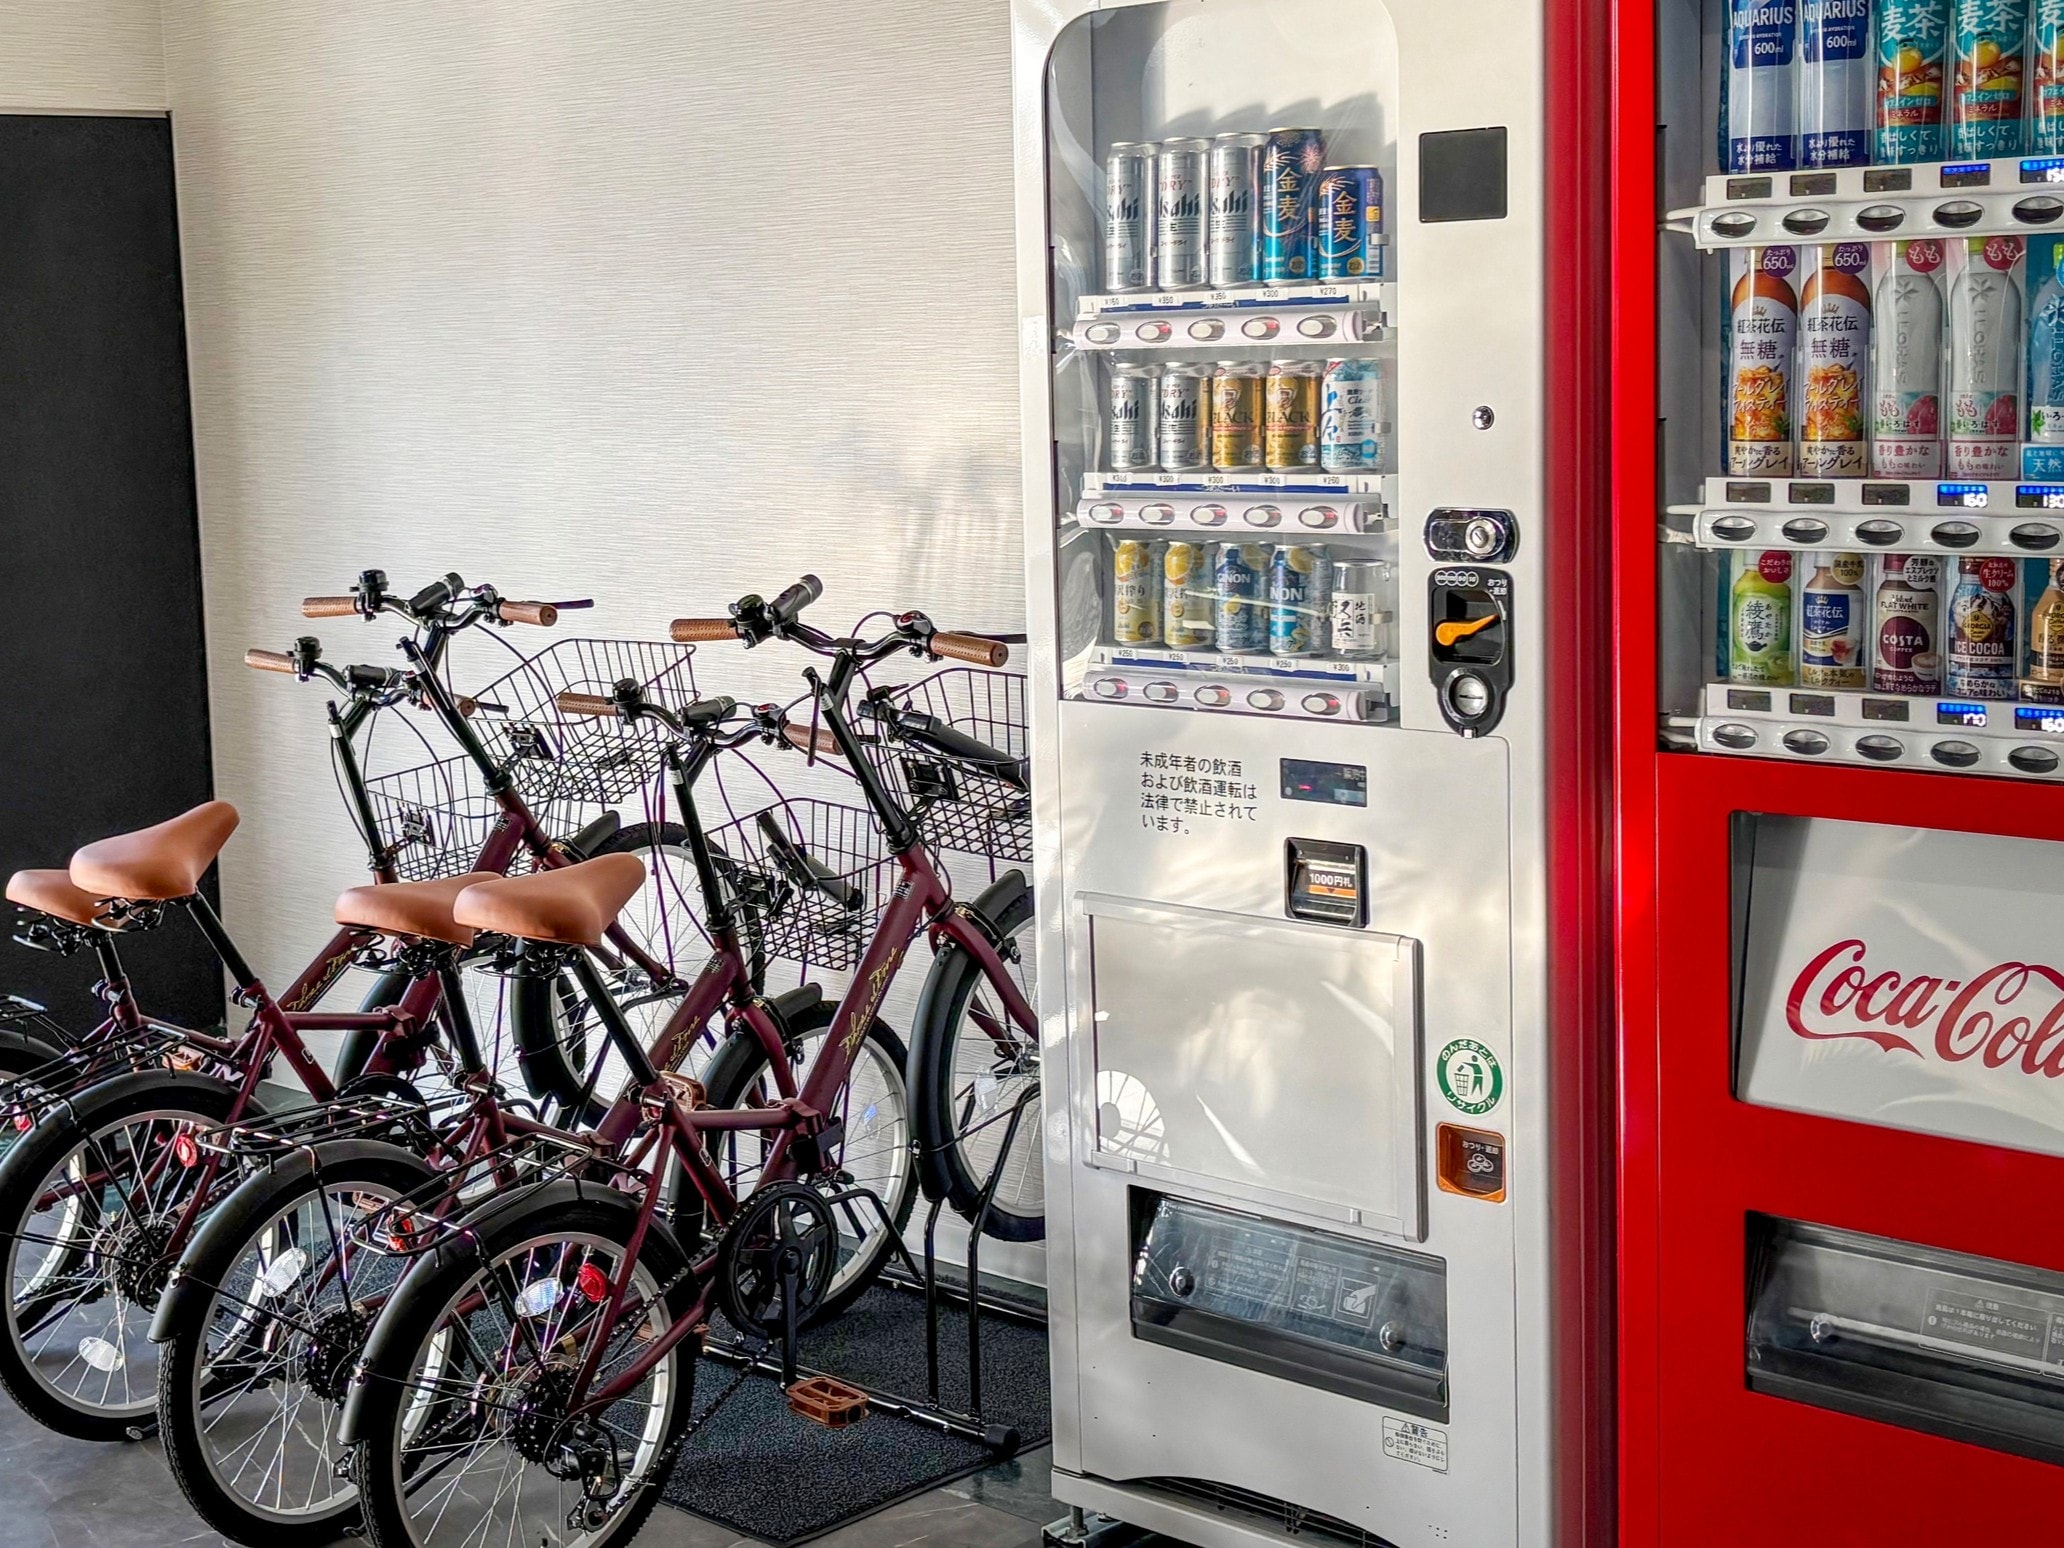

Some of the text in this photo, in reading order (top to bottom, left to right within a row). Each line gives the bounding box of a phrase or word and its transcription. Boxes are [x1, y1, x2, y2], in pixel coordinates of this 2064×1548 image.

[1734, 6, 1794, 29] AQUARIUS
[1804, 1, 1866, 22] AQUARIUS
[1882, 1, 1946, 43] 麦茶
[1957, 0, 2025, 37] 麦茶
[1277, 166, 1302, 222] 金麦
[1332, 190, 1358, 243] 金麦
[1908, 245, 1940, 264] もも
[1985, 242, 2018, 261] もも
[1737, 318, 1786, 334] 紅茶花伝
[1807, 315, 1858, 332] 紅茶花伝
[1740, 339, 1778, 360] 無糖
[1811, 337, 1851, 358] 無糖
[1879, 445, 1930, 457] 香り豊かな
[1955, 445, 2008, 457] 香り豊かな
[1900, 602, 1929, 611] WHITE
[1746, 600, 1764, 640] 綾鷹
[1883, 634, 1923, 646] COSTA
[1969, 642, 2005, 655] COCOA
[1140, 750, 1242, 777] 未成年者の飲酒
[1140, 772, 1258, 800] および飲酒運転は
[1140, 792, 1258, 821] 法律で禁止されて
[1142, 814, 1190, 835] います。
[1309, 873, 1353, 887] 1000円札
[1441, 1039, 1497, 1069] のんだあとは
[1446, 1090, 1496, 1114] リサイクル
